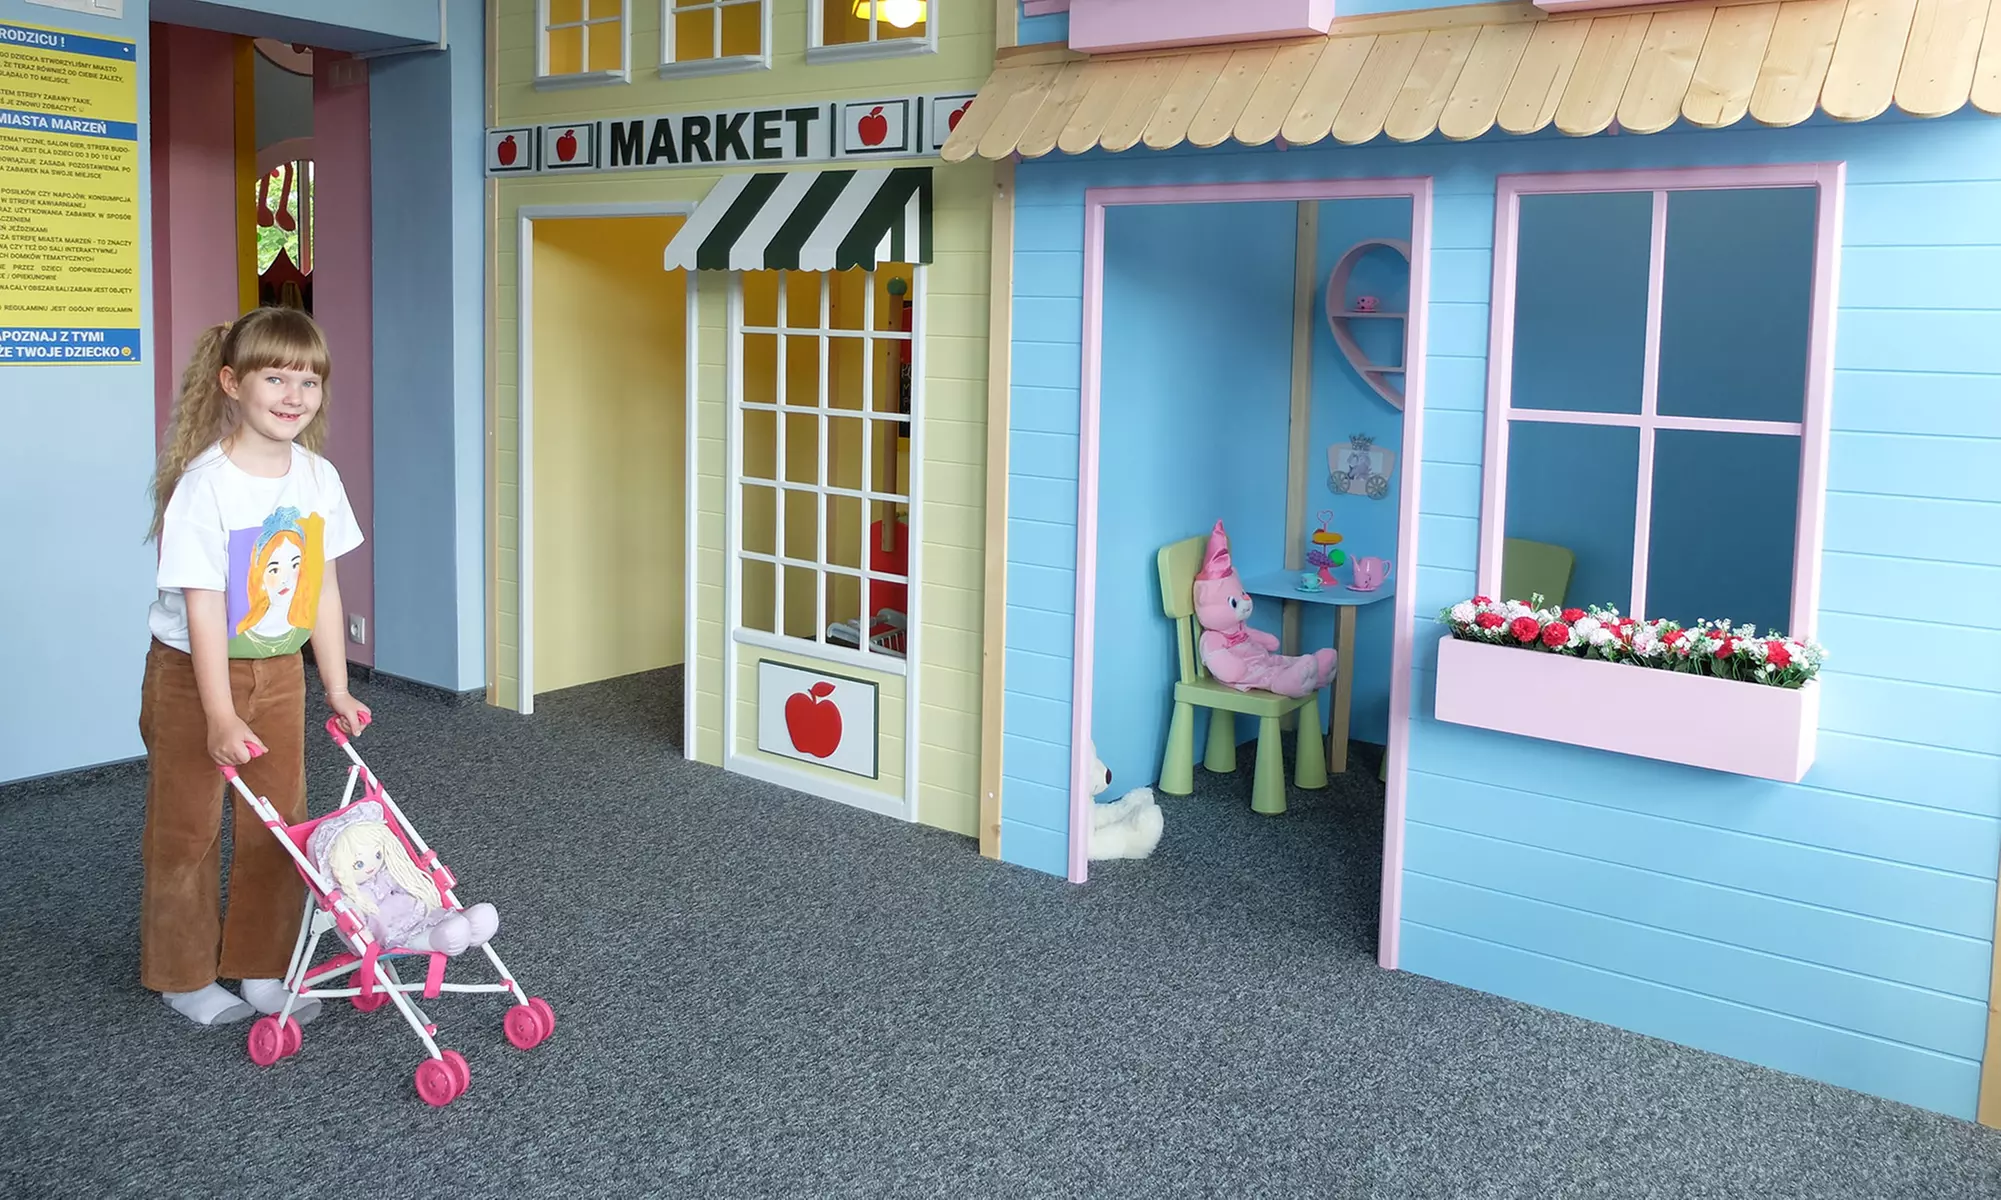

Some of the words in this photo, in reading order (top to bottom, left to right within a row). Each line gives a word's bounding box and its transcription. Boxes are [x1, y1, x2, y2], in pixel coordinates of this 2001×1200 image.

[0, 28, 57, 46] RODZICU
[11, 53, 39, 62] DZIECKA
[41, 56, 91, 68] STWORZYLIŚMY
[93, 64, 117, 73] MIASTO
[14, 62, 36, 71] TERAZ
[37, 65, 66, 75] RÓWNIEŻ
[78, 70, 98, 79] CIEBIE
[42, 103, 77, 112] ZOBACZYĆ
[52, 118, 106, 134] MARZEŃ
[610, 106, 819, 166] MARKET
[6, 166, 38, 174] ZABAWEK
[88, 195, 131, 203] KONSUMPCJA
[0, 331, 56, 342] POZNAJ
[60, 332, 69, 342] Z
[72, 332, 104, 342] TYMI
[16, 347, 62, 357] TWOJE
[65, 347, 120, 357] DZIECKO
